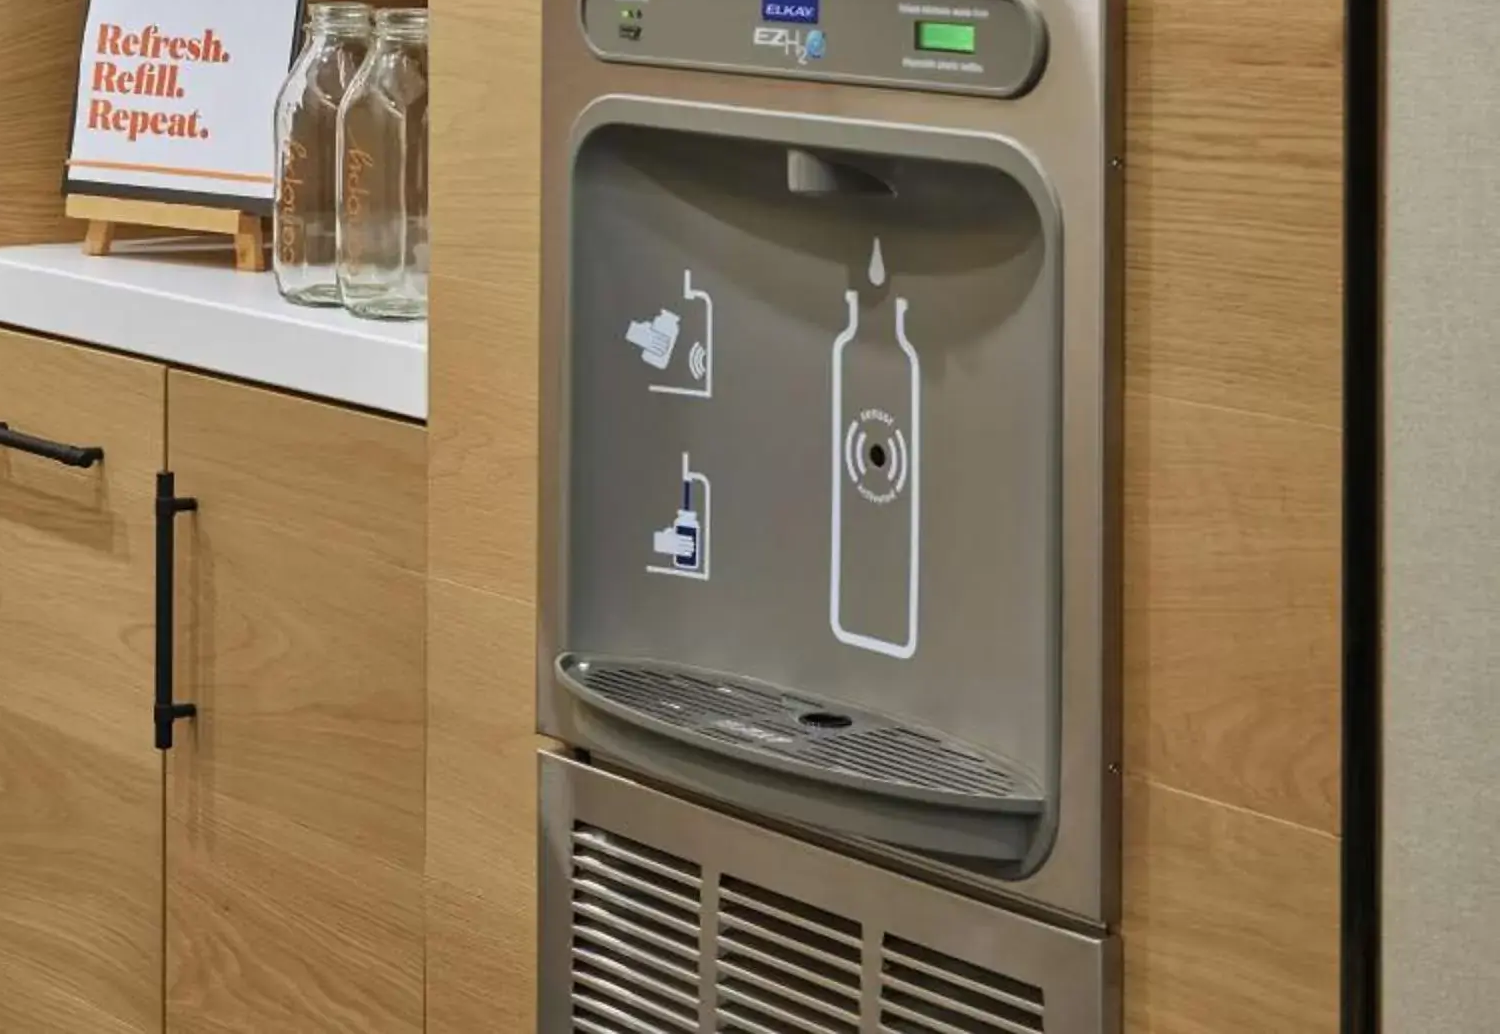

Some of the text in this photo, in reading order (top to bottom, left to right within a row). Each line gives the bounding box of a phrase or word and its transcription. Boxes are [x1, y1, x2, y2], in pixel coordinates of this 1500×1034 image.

[766, 4, 816, 17] ELKAY
[97, 23, 230, 63] Refresh.
[92, 61, 185, 98] Refill.
[87, 99, 209, 141] Repeat.
